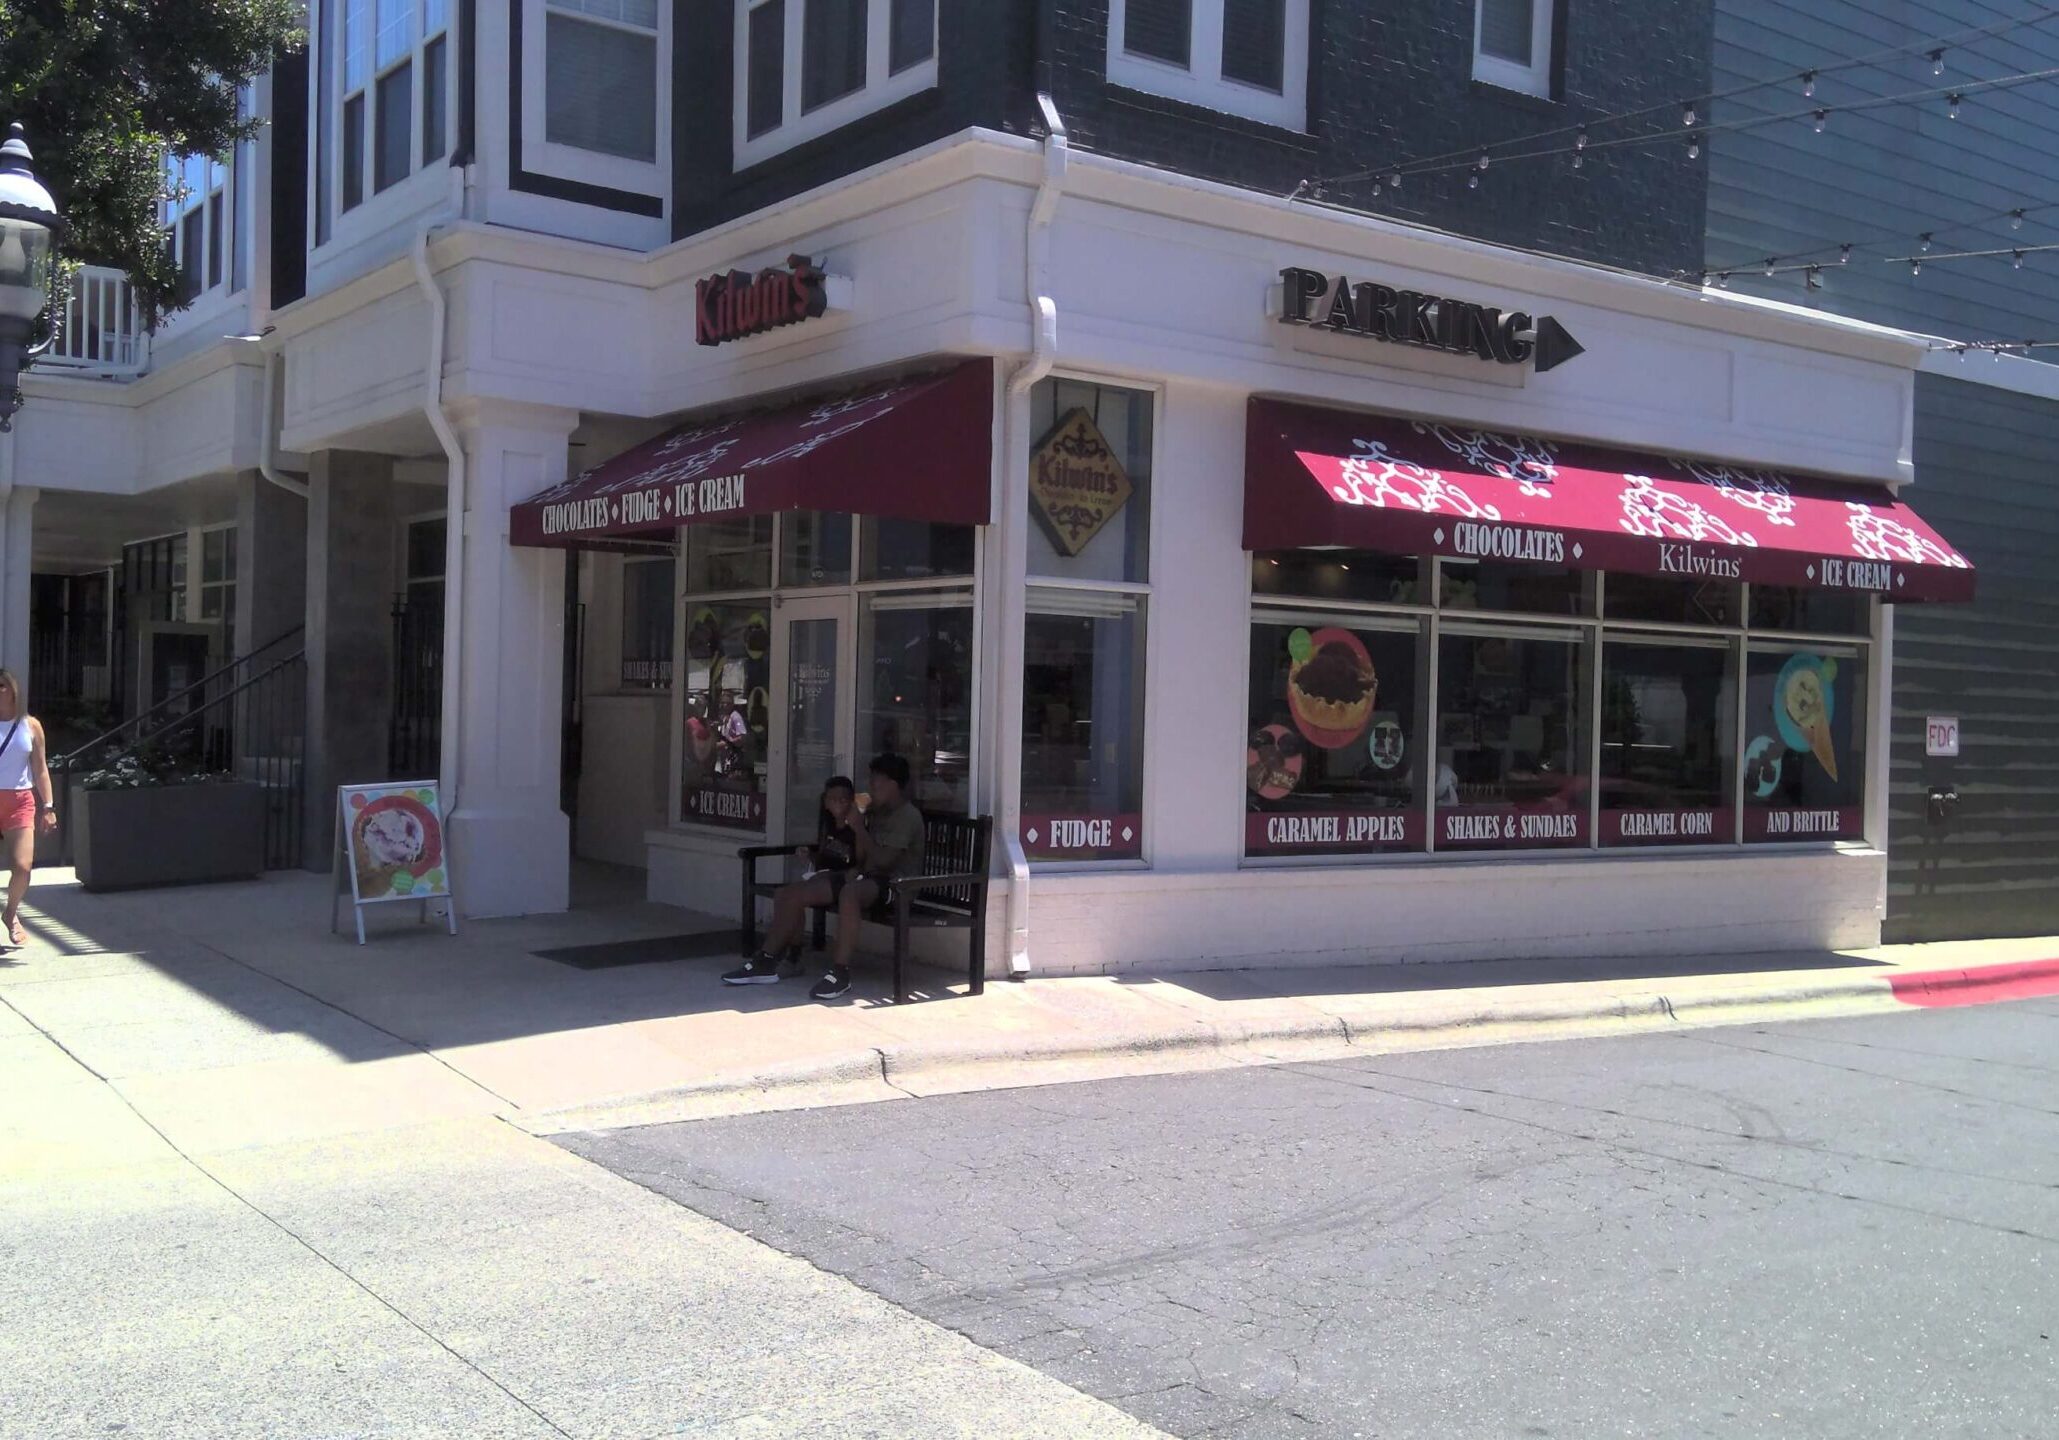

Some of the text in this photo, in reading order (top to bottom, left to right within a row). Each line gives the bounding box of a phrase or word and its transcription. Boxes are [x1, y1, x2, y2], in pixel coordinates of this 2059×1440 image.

[1279, 267, 1532, 364] PARKING
[542, 474, 745, 535] CHOCOLATES FUDGE ICE CREAM
[1454, 521, 1564, 563] CHOCOLATES
[1658, 543, 1740, 578] Kilwins
[1821, 559, 1891, 591] ICE CREAM
[1929, 725, 1956, 748] FDC
[700, 790, 750, 819] ICE CREAM
[1050, 819, 1112, 848] FUDGE
[1267, 816, 1404, 843] CARAMEL APPLES
[1447, 815, 1577, 839] SHAKES & SUNDAES
[1620, 813, 1713, 836] CARAMEL CORN
[1767, 811, 1839, 833] AND BRITTLE
